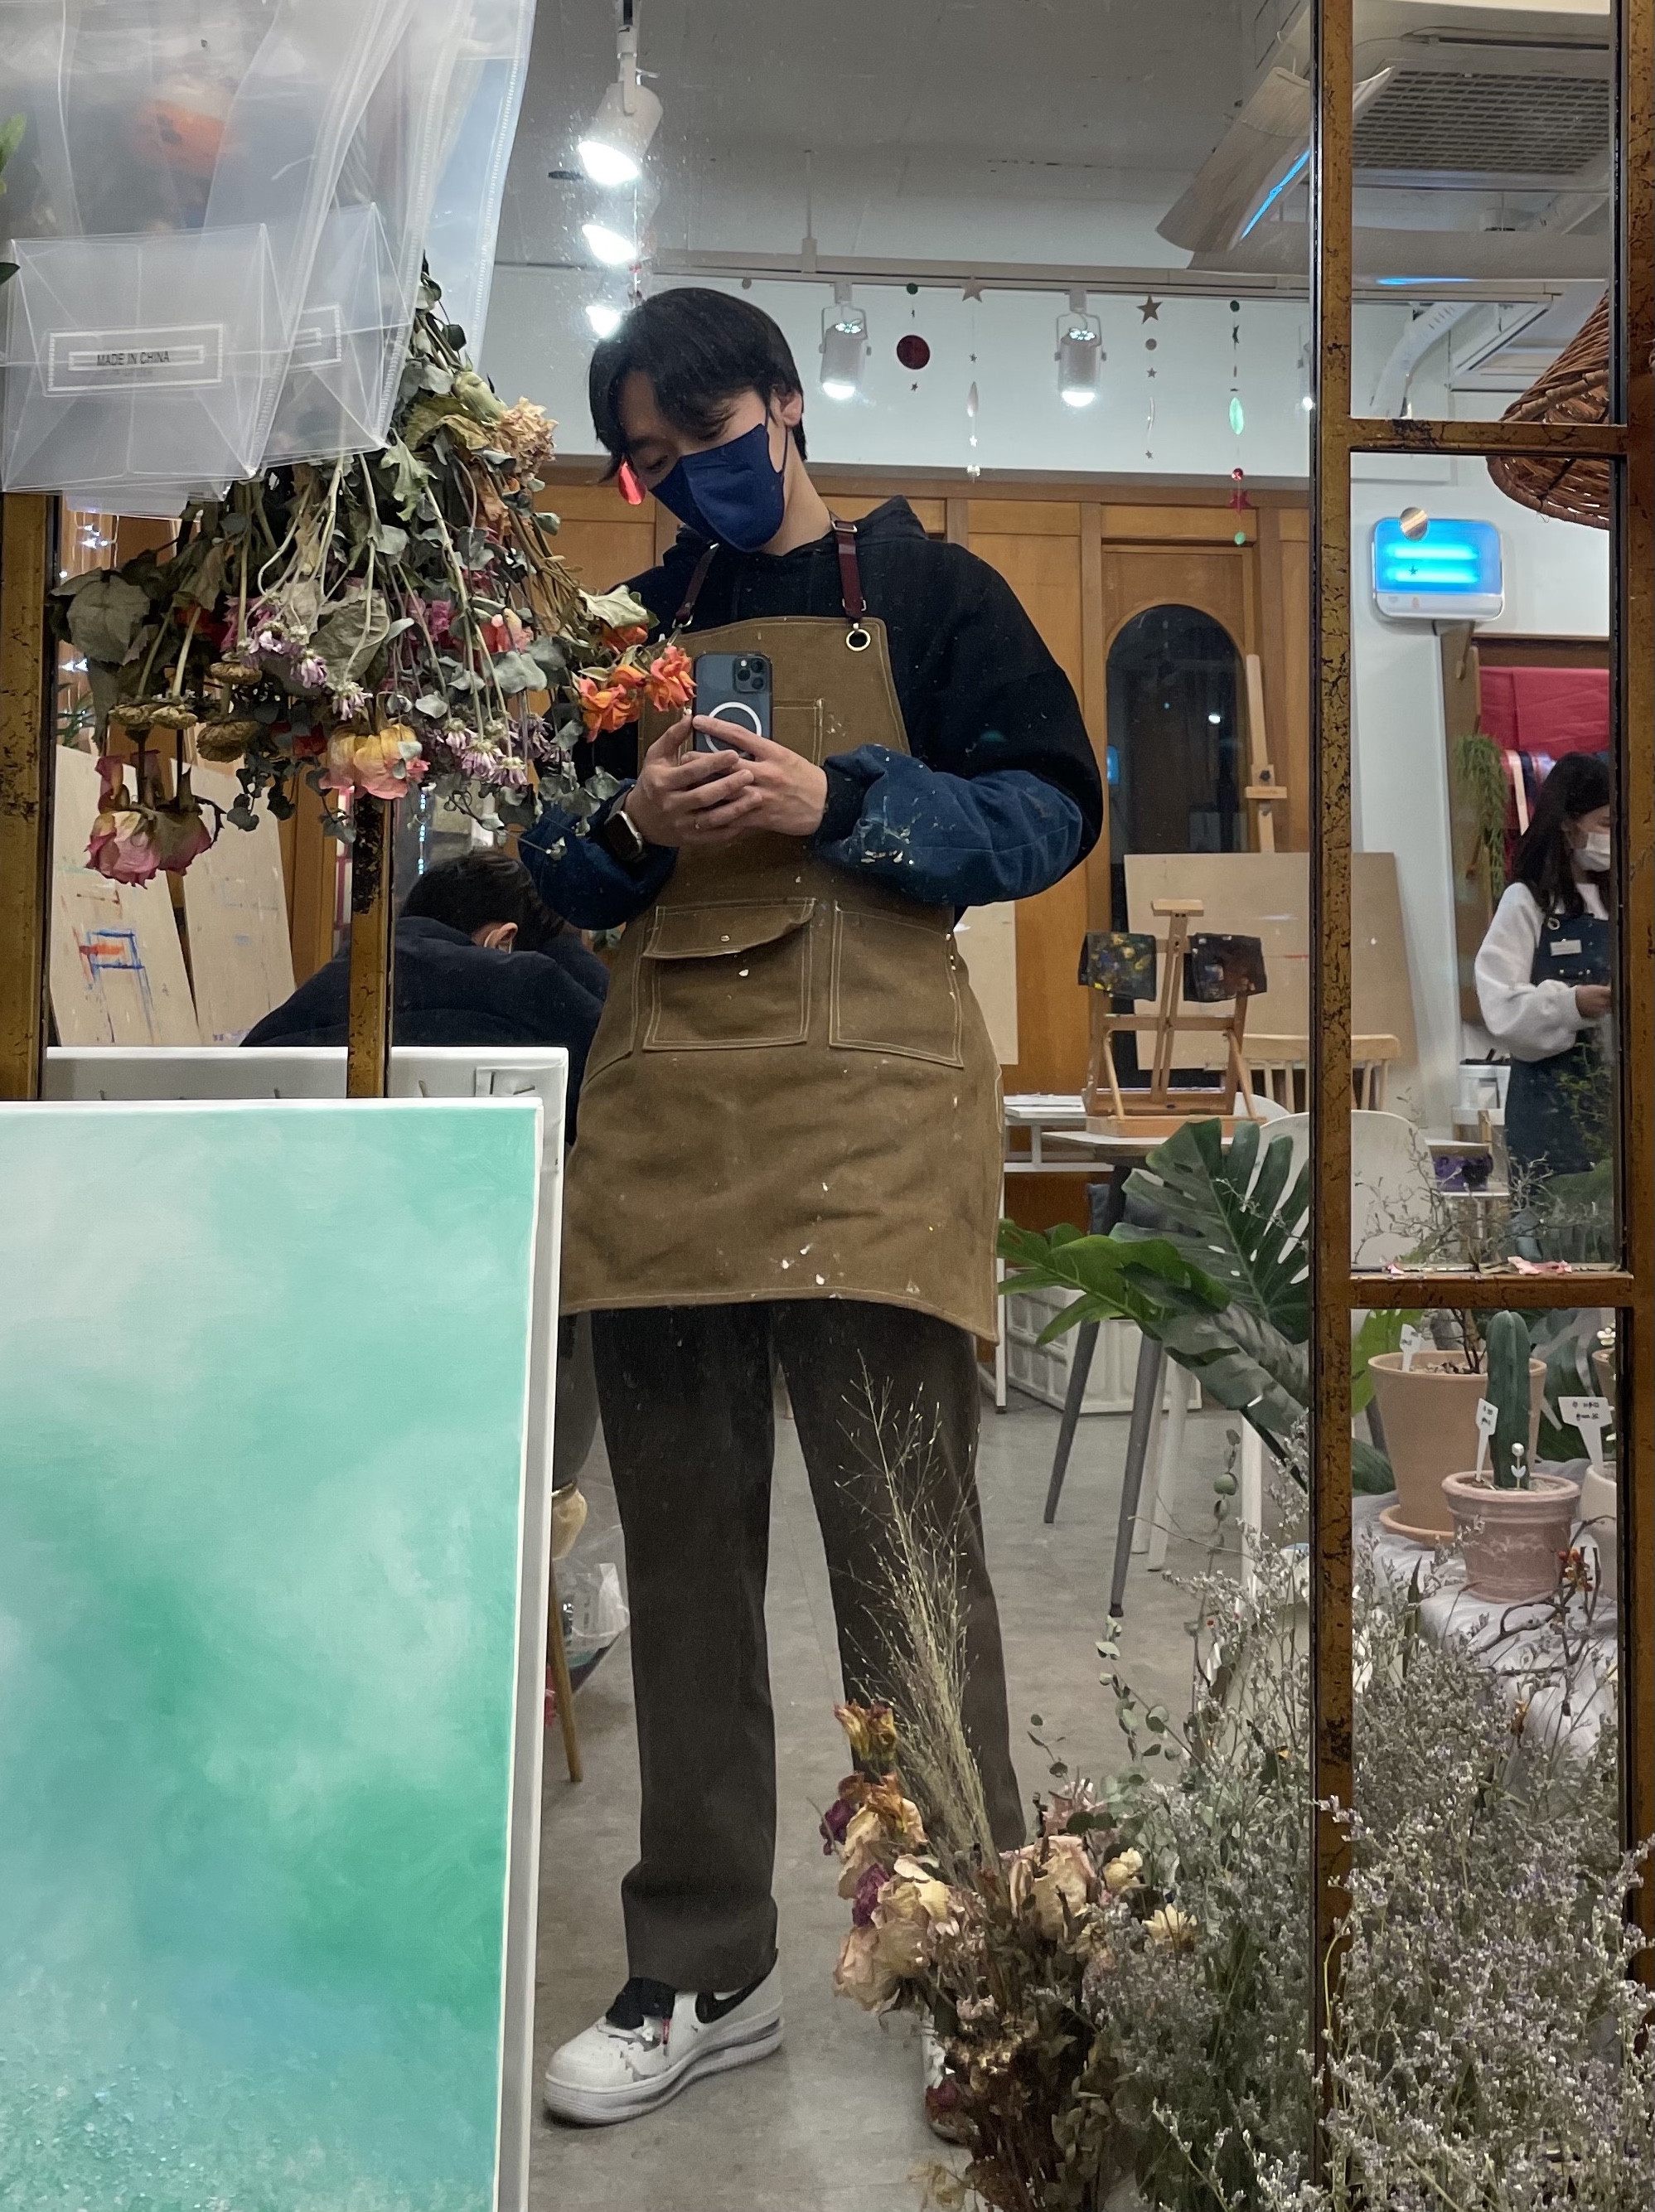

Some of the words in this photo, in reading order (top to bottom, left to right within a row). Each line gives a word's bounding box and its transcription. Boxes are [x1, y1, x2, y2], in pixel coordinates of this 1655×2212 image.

[97, 354, 124, 366] MADE
[128, 352, 137, 365] IN
[139, 351, 170, 364] CHINA
